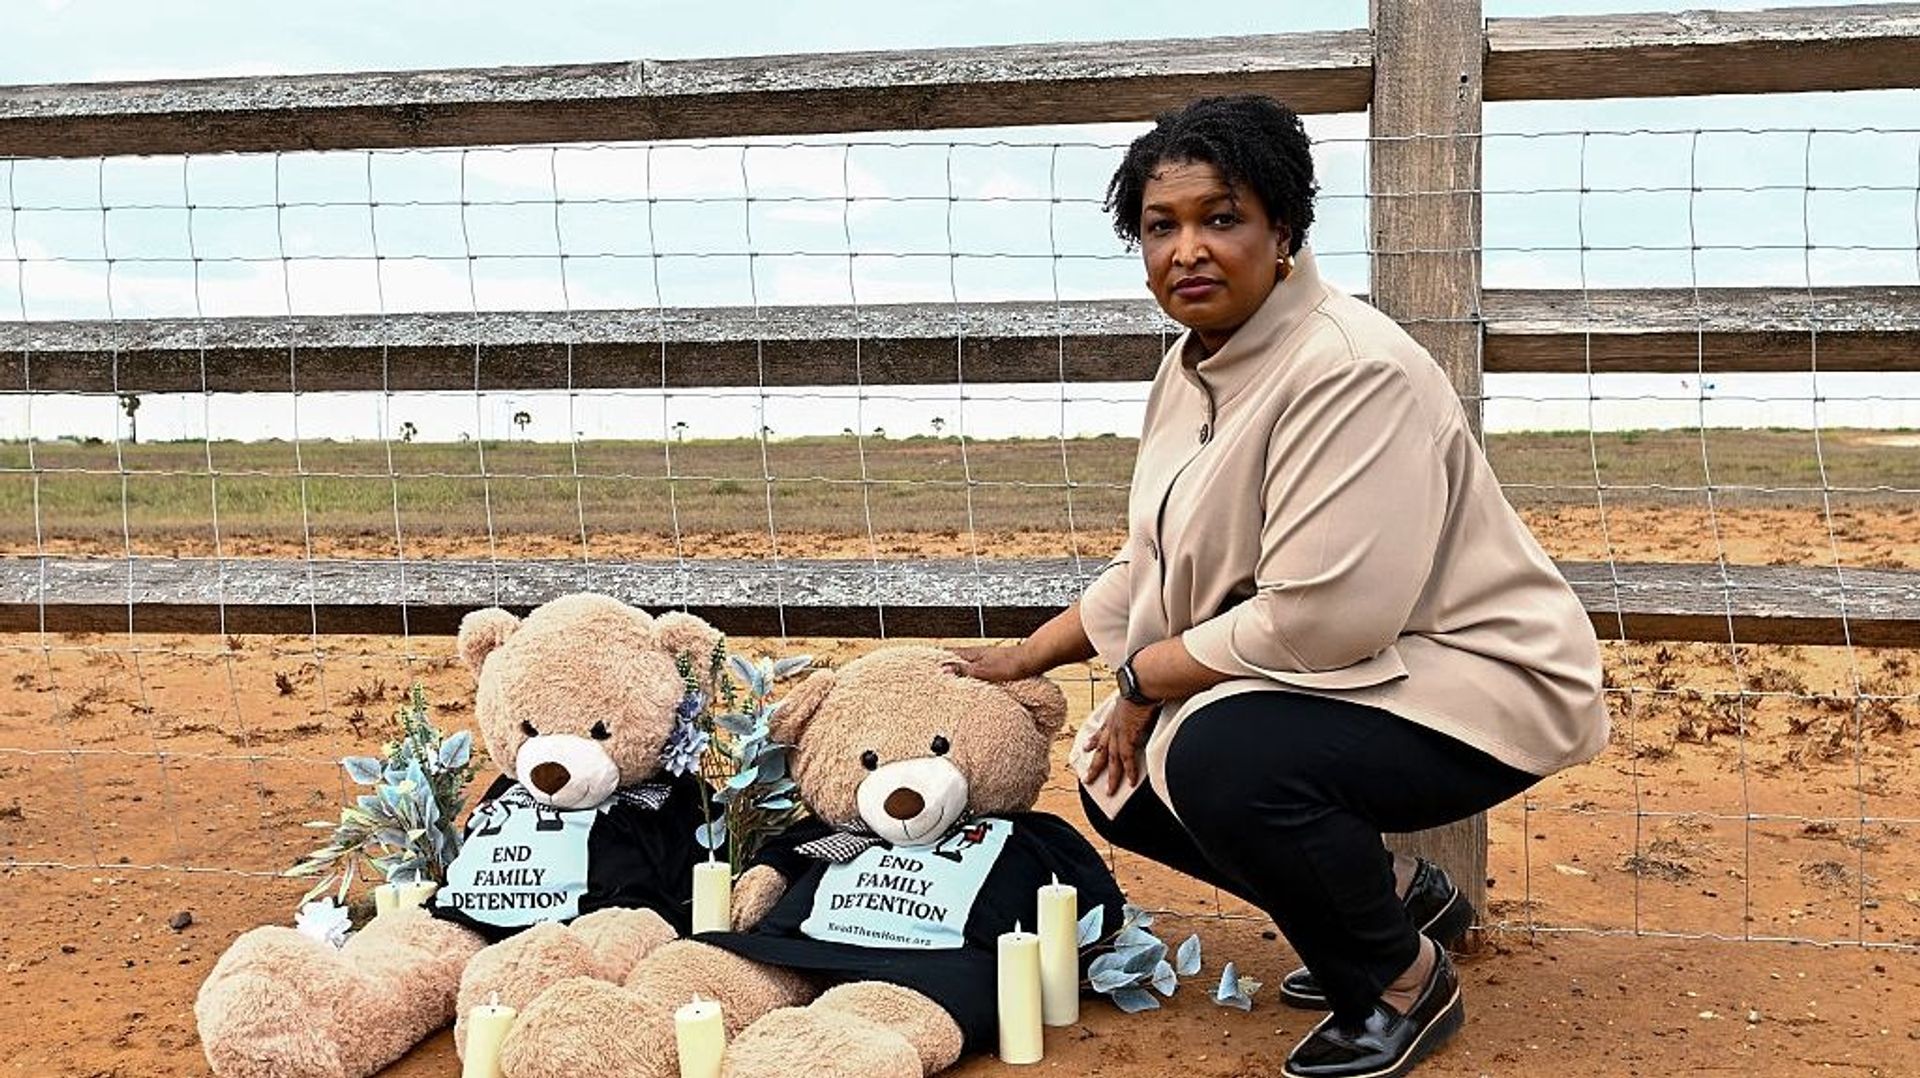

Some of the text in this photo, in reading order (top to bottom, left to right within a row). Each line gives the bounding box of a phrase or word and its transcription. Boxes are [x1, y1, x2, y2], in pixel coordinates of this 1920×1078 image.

[492, 846, 532, 863] END
[878, 854, 924, 873] END
[472, 868, 546, 887] FAMILY
[856, 872, 934, 897] FAMILY
[451, 891, 568, 911] DETENTION
[830, 892, 948, 923] DETENTION
